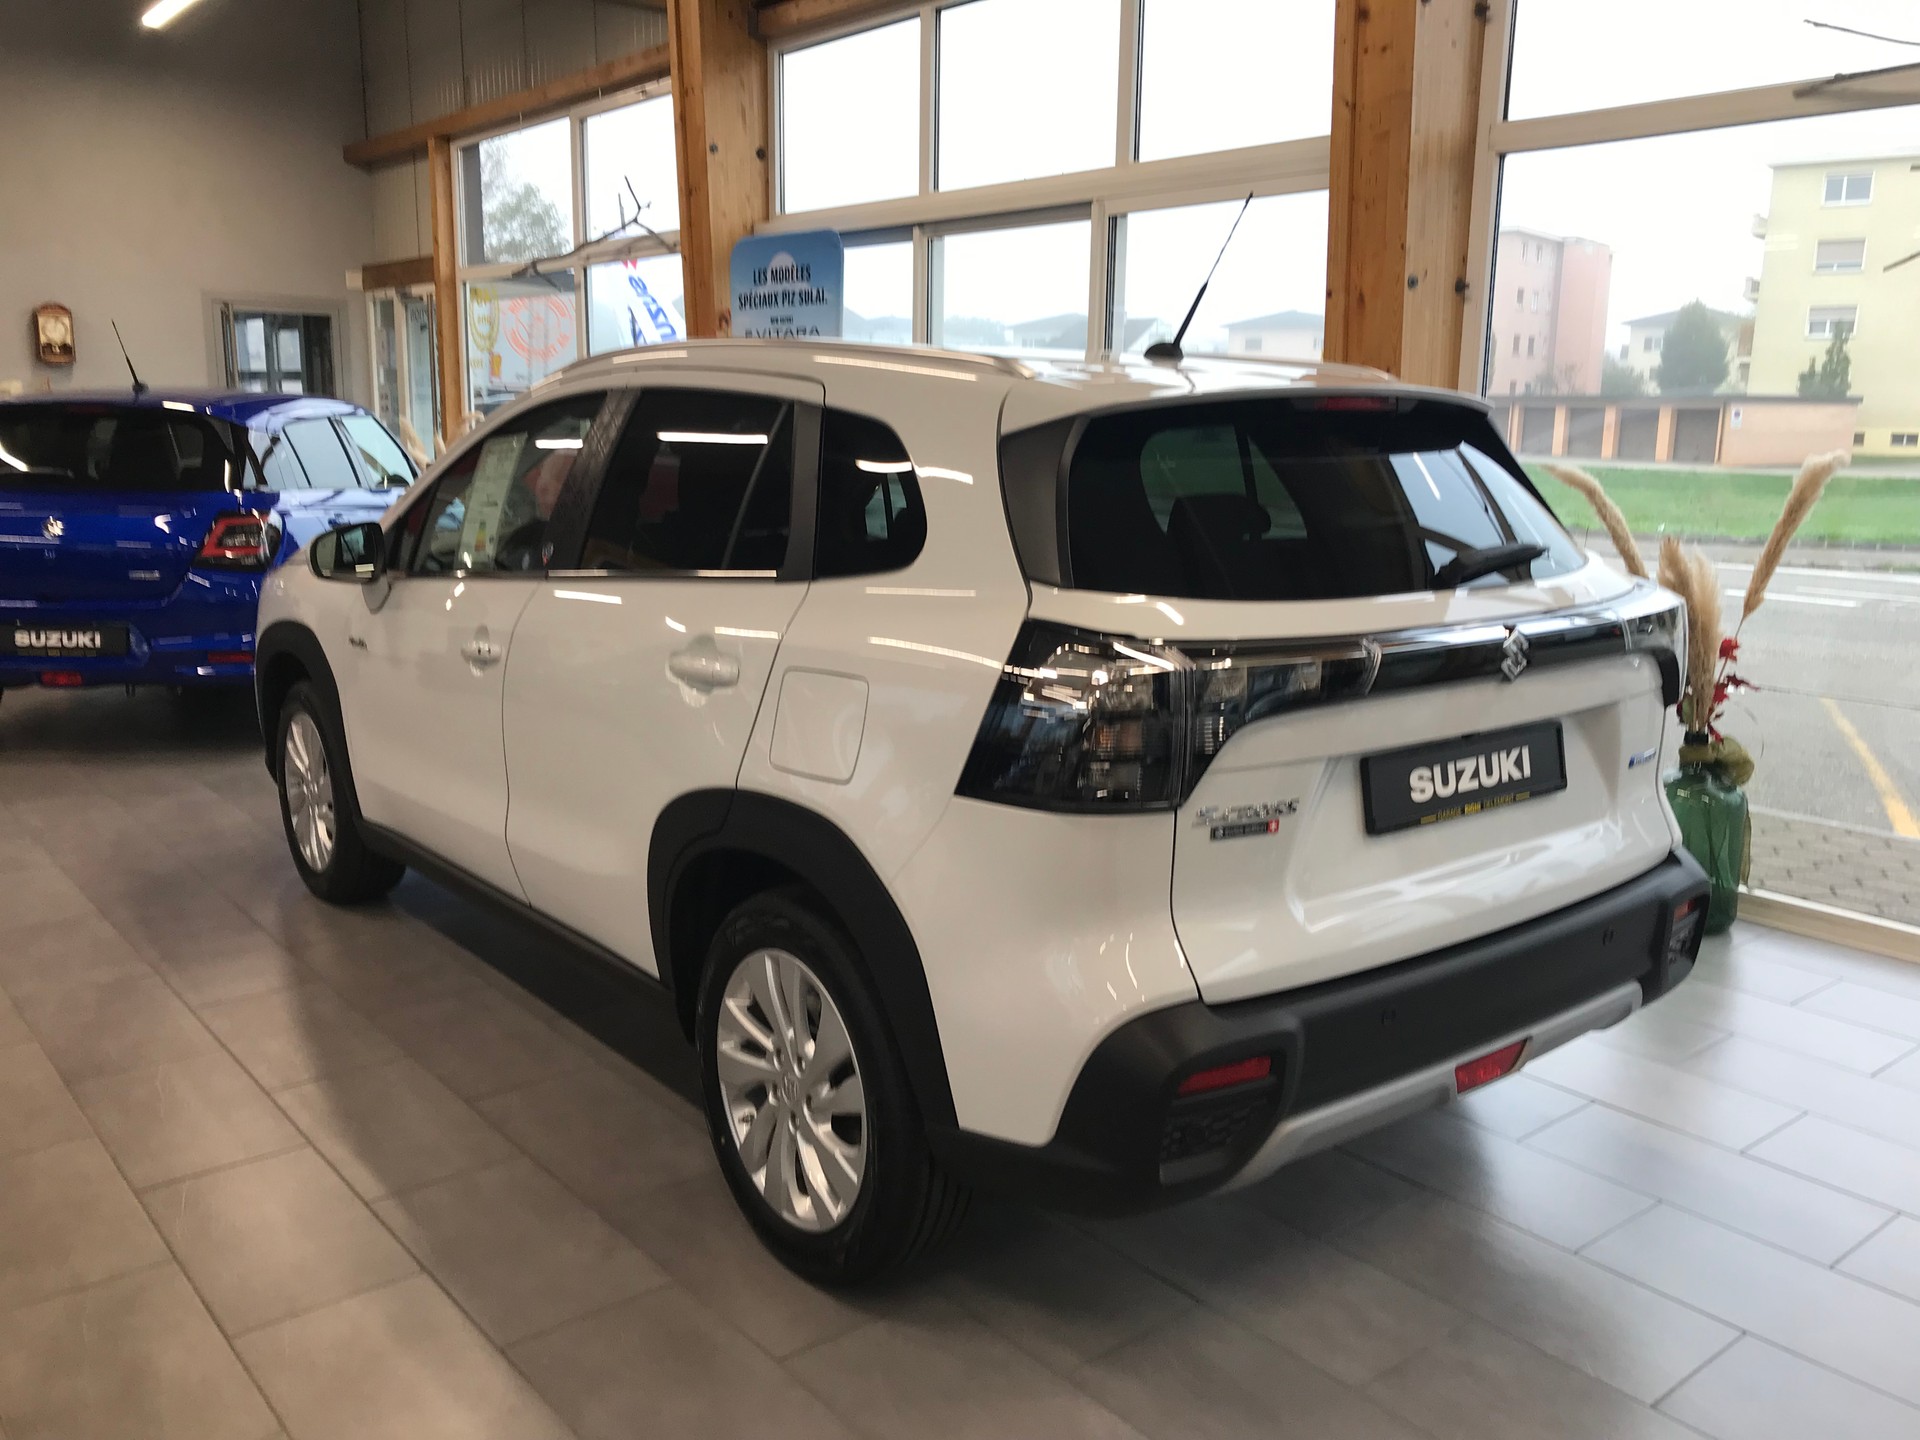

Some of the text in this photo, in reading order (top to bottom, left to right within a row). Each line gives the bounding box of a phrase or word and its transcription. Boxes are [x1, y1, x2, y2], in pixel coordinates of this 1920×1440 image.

[753, 262, 811, 286] LES MODÈLES
[738, 290, 779, 311] SPÉCIAUX
[781, 289, 796, 308] PIZ
[14, 629, 101, 648] SUZUKI
[1409, 745, 1531, 803] SUZUKI
